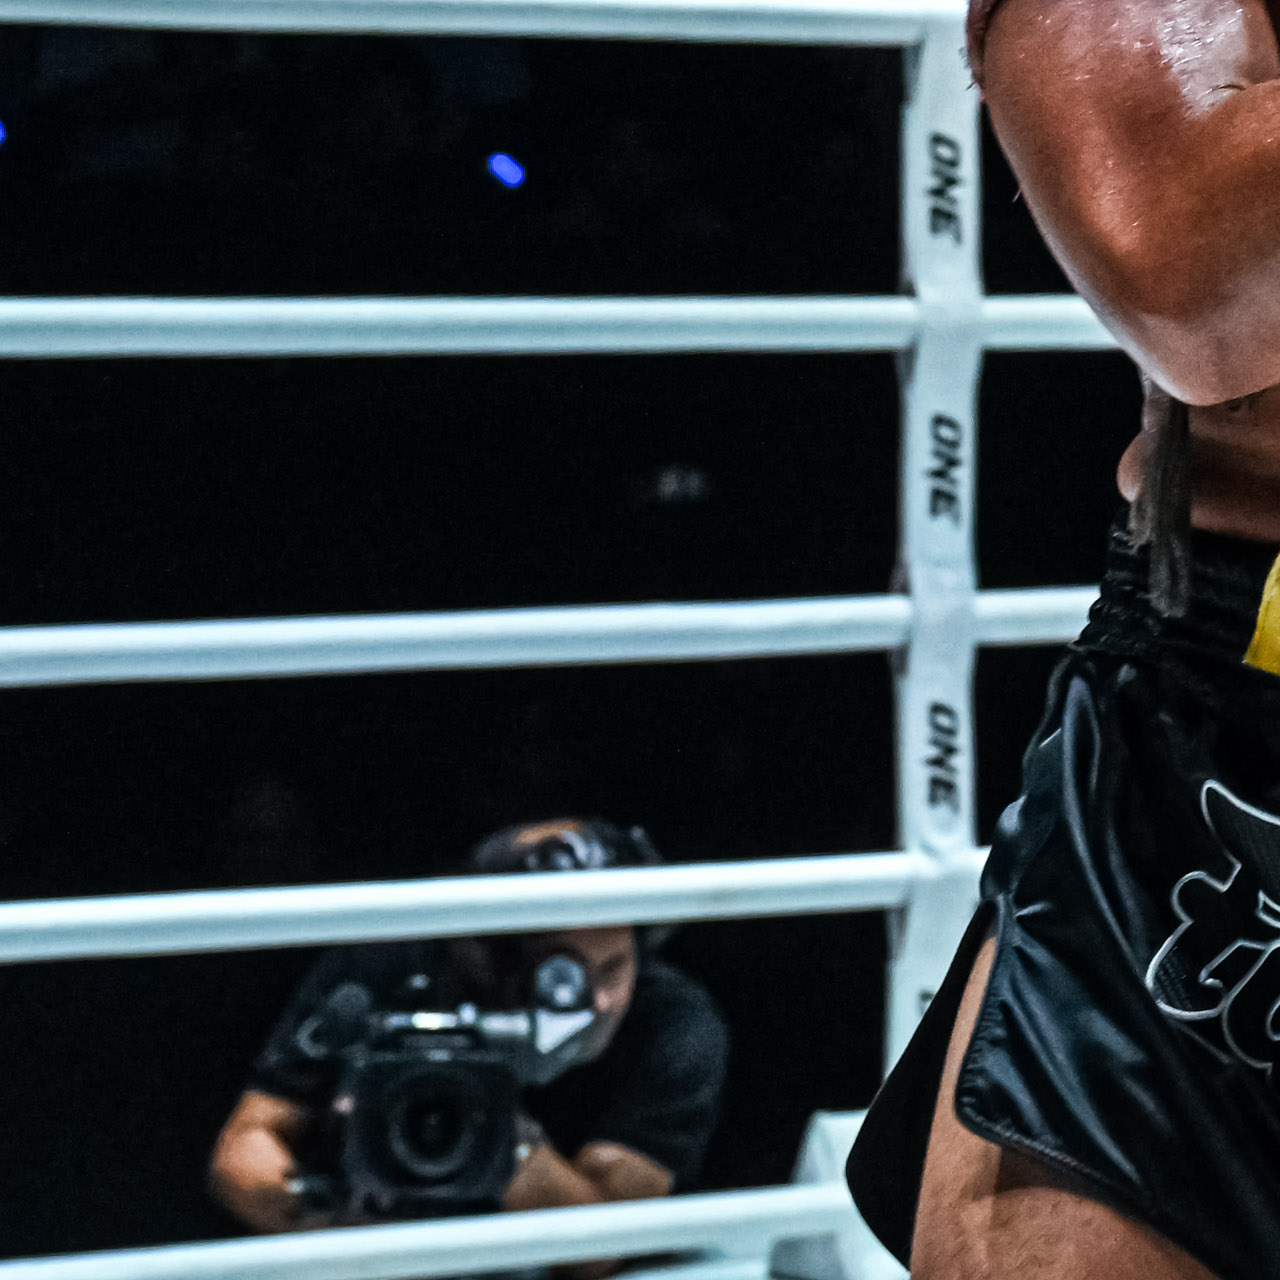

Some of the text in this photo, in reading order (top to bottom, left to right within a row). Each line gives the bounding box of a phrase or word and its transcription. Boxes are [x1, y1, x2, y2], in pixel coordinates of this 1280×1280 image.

[926, 132, 962, 245] ONE
[926, 413, 961, 527] ONE
[926, 702, 960, 814] ONE
